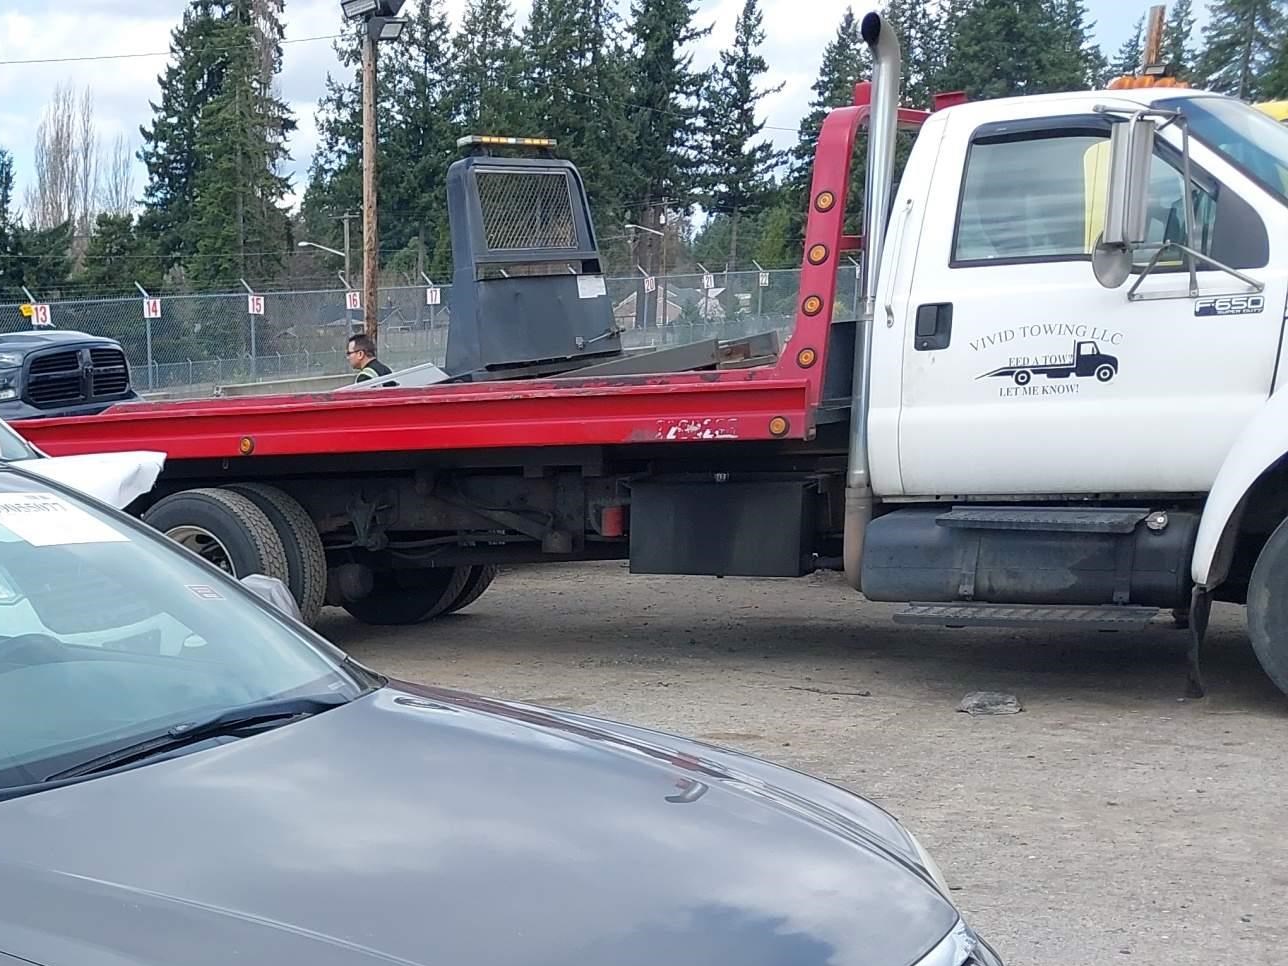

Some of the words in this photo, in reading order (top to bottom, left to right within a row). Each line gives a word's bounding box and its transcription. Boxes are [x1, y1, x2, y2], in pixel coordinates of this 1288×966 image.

[348, 293, 358, 308] 16
[430, 289, 438, 303] 17
[146, 300, 158, 316] 14
[251, 297, 262, 313] 15
[34, 305, 48, 323] 13
[968, 328, 1016, 352] VIVID
[1018, 323, 1088, 339] TOWING
[1090, 326, 1124, 345] LLC
[999, 386, 1020, 397] LET
[1022, 385, 1039, 396] ME
[1041, 383, 1080, 395] KNOW!
